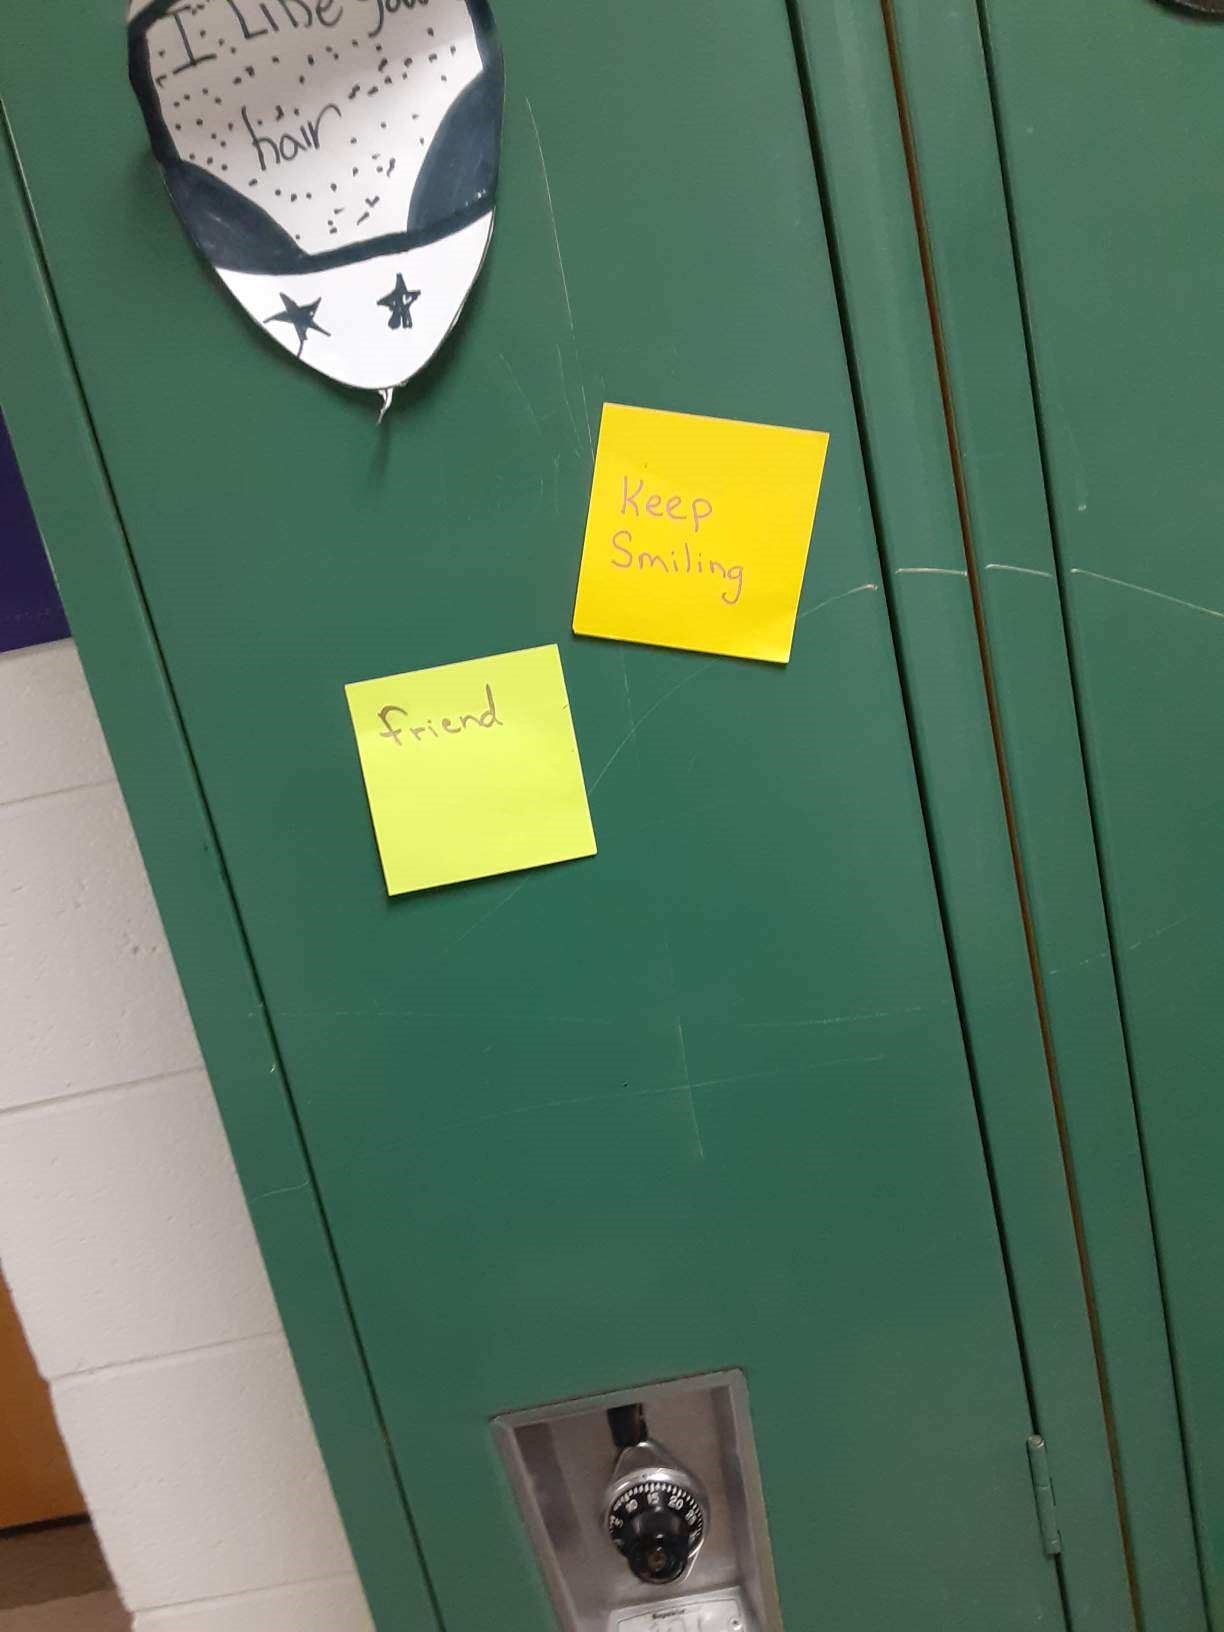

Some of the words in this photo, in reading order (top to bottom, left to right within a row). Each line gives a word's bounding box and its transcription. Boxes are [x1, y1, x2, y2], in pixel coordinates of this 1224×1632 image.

[242, 104, 341, 171] hair
[621, 475, 713, 532] Keep
[611, 530, 743, 604] Smiling
[377, 683, 503, 746] friend
[668, 1495, 684, 1511] 20
